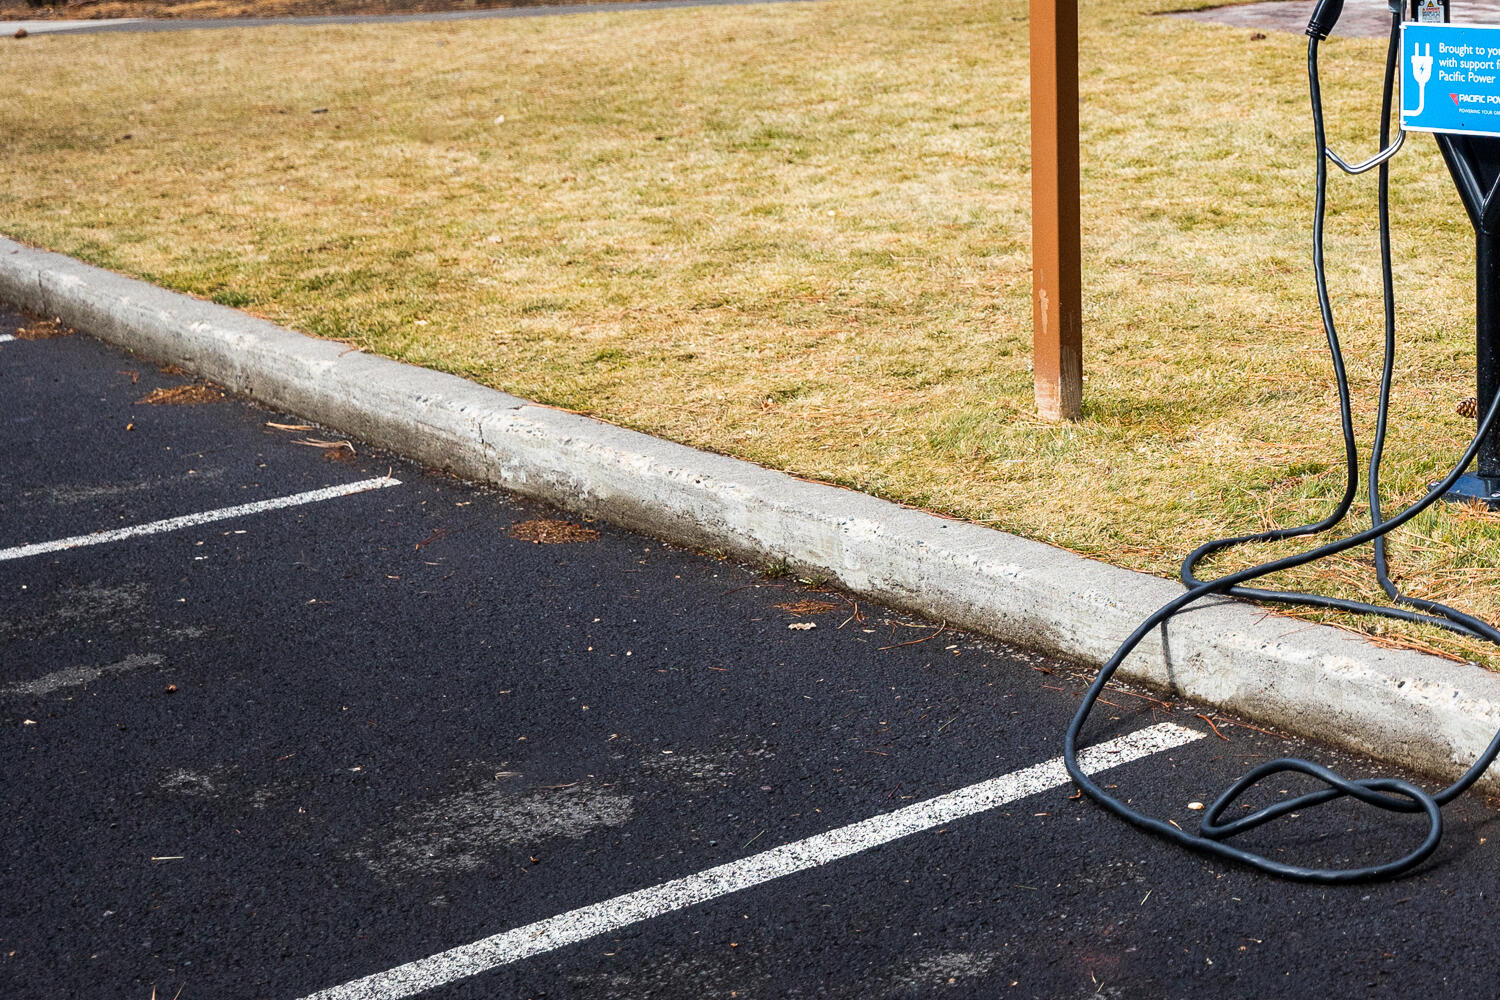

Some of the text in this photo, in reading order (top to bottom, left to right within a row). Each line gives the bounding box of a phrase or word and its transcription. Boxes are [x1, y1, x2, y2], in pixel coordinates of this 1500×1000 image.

[1439, 42, 1474, 57] Brought
[1475, 46, 1485, 55] to
[1439, 57, 1457, 68] with
[1460, 60, 1494, 71] support
[1439, 70, 1496, 84] Pacific Power
[1458, 93, 1486, 104] PACIFIC
